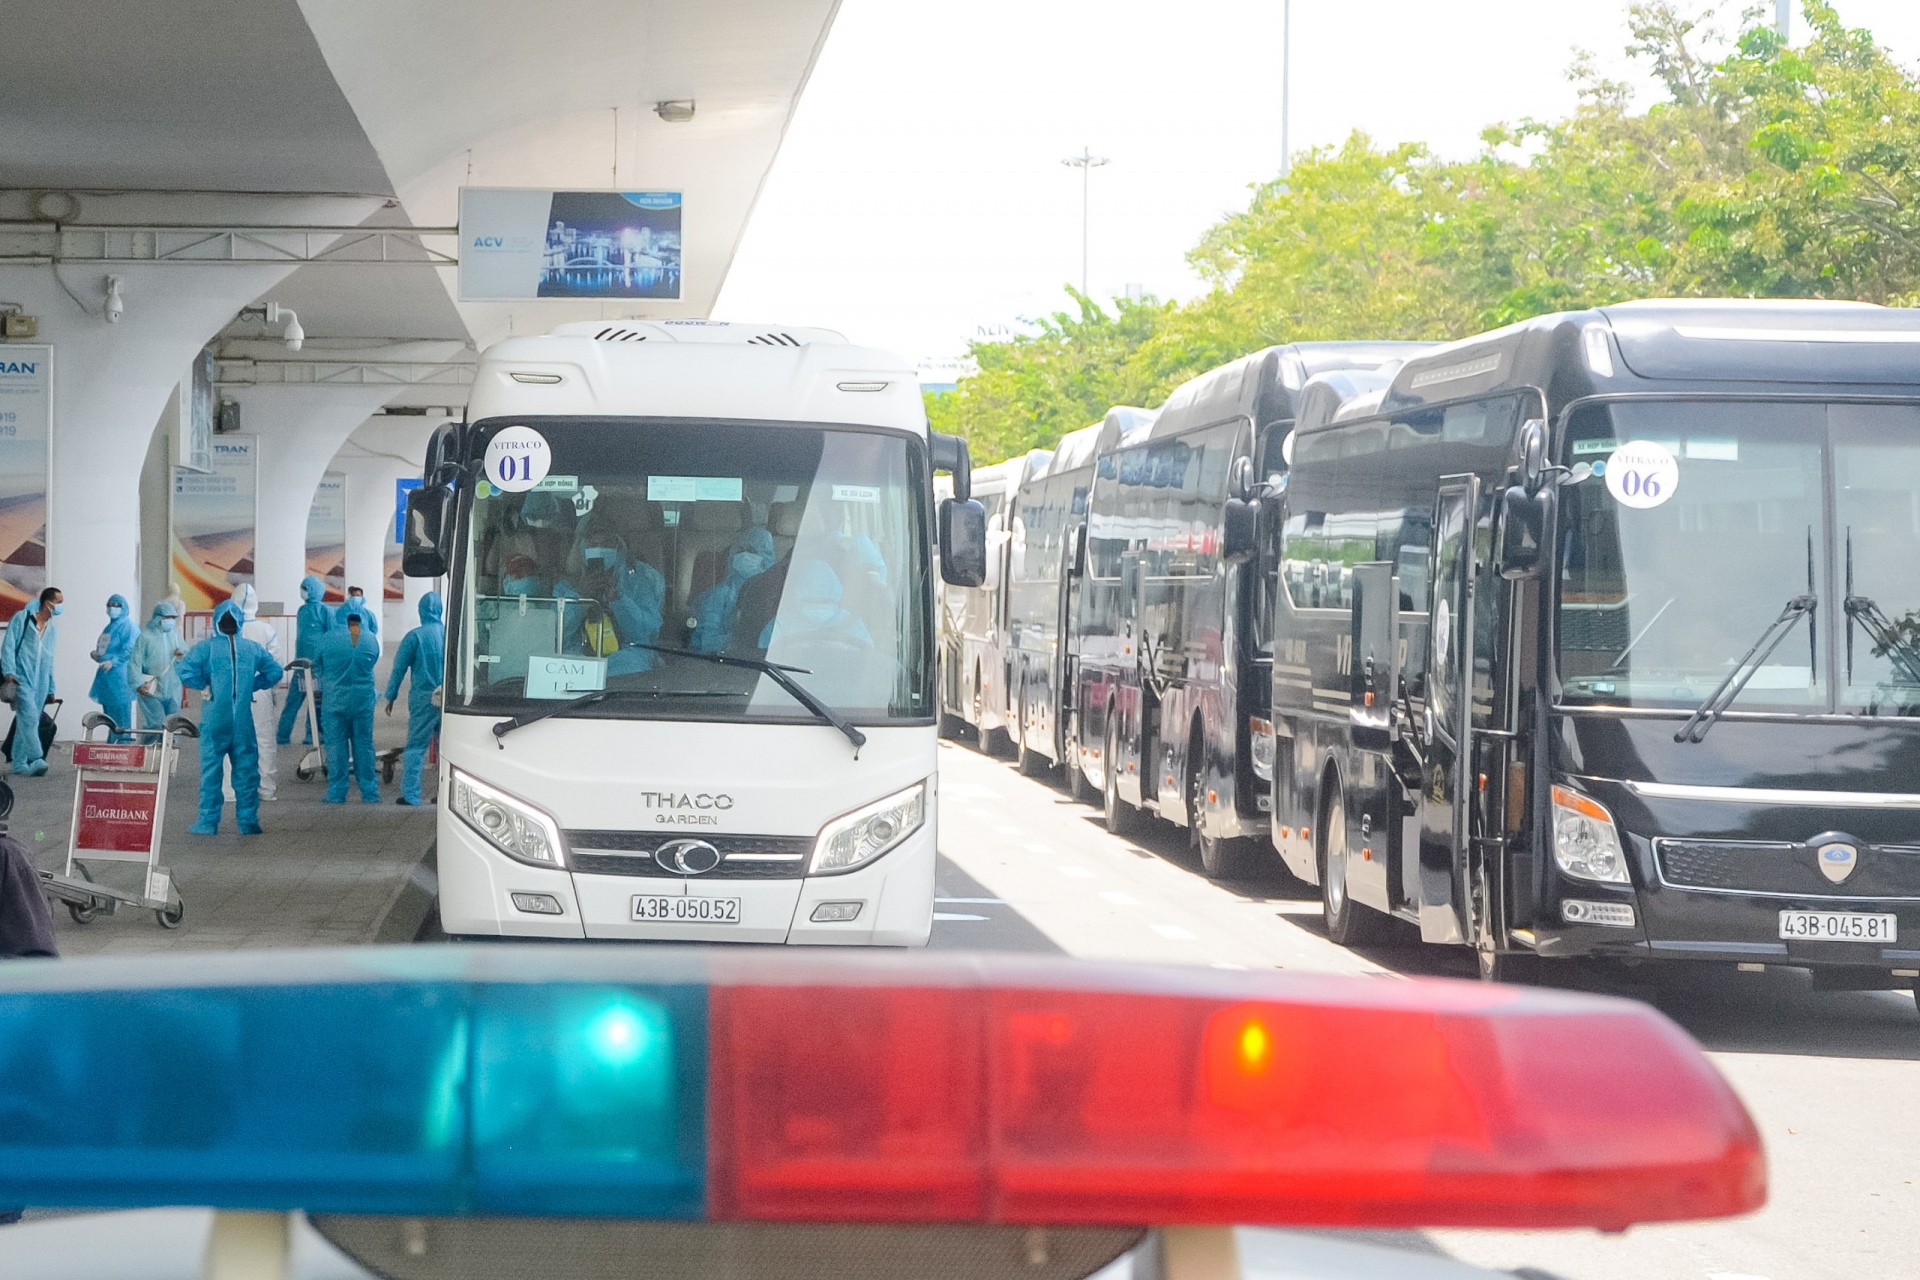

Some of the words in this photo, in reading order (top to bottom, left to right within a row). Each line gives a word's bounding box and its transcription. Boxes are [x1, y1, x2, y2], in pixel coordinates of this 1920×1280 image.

[474, 236, 503, 247] ACV
[494, 441, 542, 450] VITRACO
[499, 455, 533, 481] 01
[1622, 470, 1662, 498] 06
[641, 792, 734, 810] THACO
[96, 808, 149, 821] AGRIBANK
[655, 814, 718, 825] GARDEN
[636, 898, 736, 920] 43B-050.52
[1784, 915, 1887, 938] 43B-045.81
